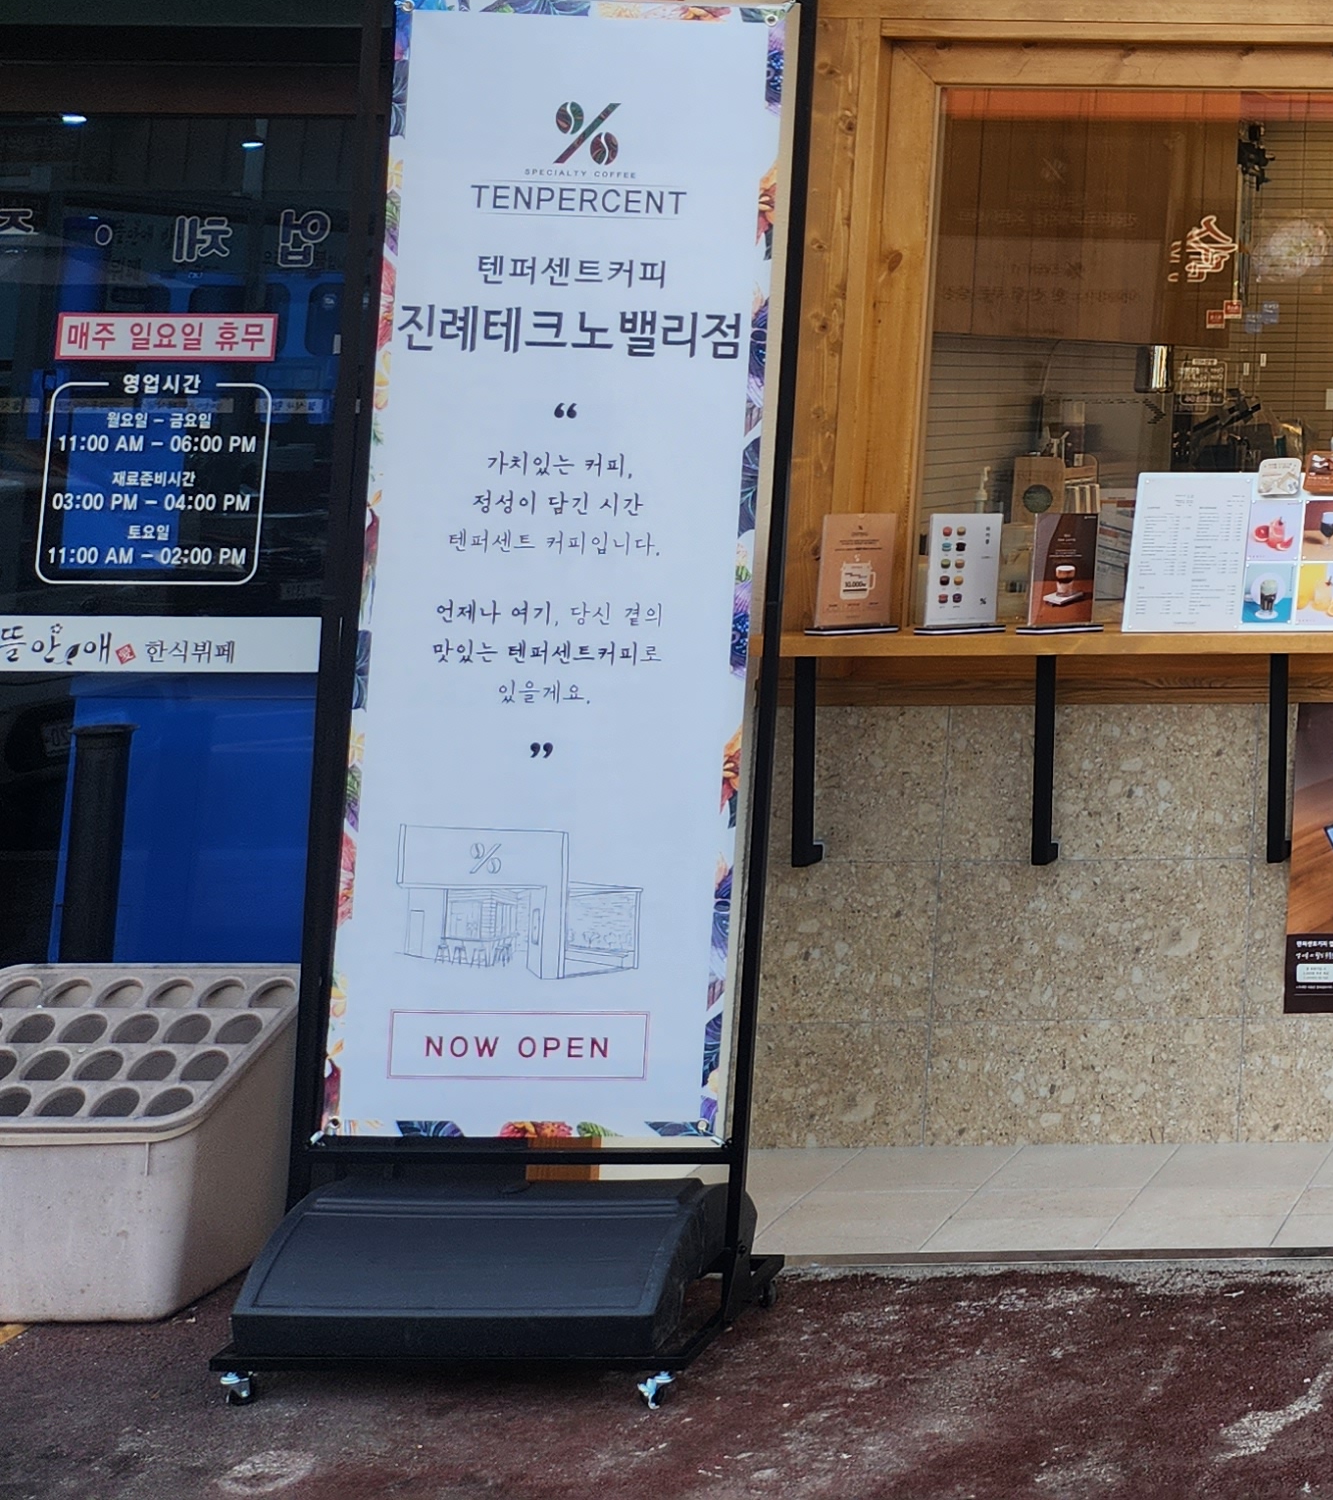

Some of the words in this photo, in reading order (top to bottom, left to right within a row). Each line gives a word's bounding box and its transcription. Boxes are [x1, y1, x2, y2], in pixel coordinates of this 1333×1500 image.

[524, 168, 588, 178] SPECIALTY
[594, 170, 637, 179] COFFEE
[470, 184, 687, 215] TENPERCENT
[477, 255, 667, 289] 텐퍼센트커피
[67, 321, 116, 350] 매주
[130, 321, 203, 351] 일요일
[215, 321, 266, 352] 휴무
[397, 303, 742, 360] 진례테크노밸리점
[123, 373, 202, 395] 영업시간
[106, 412, 148, 429] 월요일
[169, 412, 212, 430] 금요일
[58, 434, 109, 453] 11:00
[115, 435, 144, 453] AM
[169, 435, 223, 453] 06:00
[229, 435, 257, 453] PM
[487, 451, 575, 476] 가치있는
[584, 452, 633, 480] 커피,
[112, 471, 196, 488] 재료준비시간
[52, 492, 104, 511] 03:00
[110, 493, 138, 511] PM
[163, 493, 217, 512] 04:00
[223, 494, 250, 512] PM
[472, 489, 537, 515] 정성이
[548, 491, 589, 516] 담긴
[599, 492, 644, 517] 시간
[127, 524, 170, 541] 토요일
[449, 528, 536, 553] 텐퍼센트
[546, 530, 661, 557] 커피입니다.
[48, 547, 99, 565] 11:00
[104, 547, 134, 565] AM
[159, 547, 213, 566] 02:00
[219, 548, 247, 566] PM
[436, 599, 502, 625] 언제나
[511, 600, 558, 627] 여기,
[570, 601, 611, 627] 당신
[624, 602, 663, 627] 곁의
[144, 639, 236, 665] 한식뷔페
[432, 638, 499, 664] 맛있는
[507, 639, 662, 667] 텐퍼센트커피로
[498, 679, 591, 704] 있을게요.
[424, 1035, 500, 1059] NOW
[518, 1036, 610, 1059] OPEN
